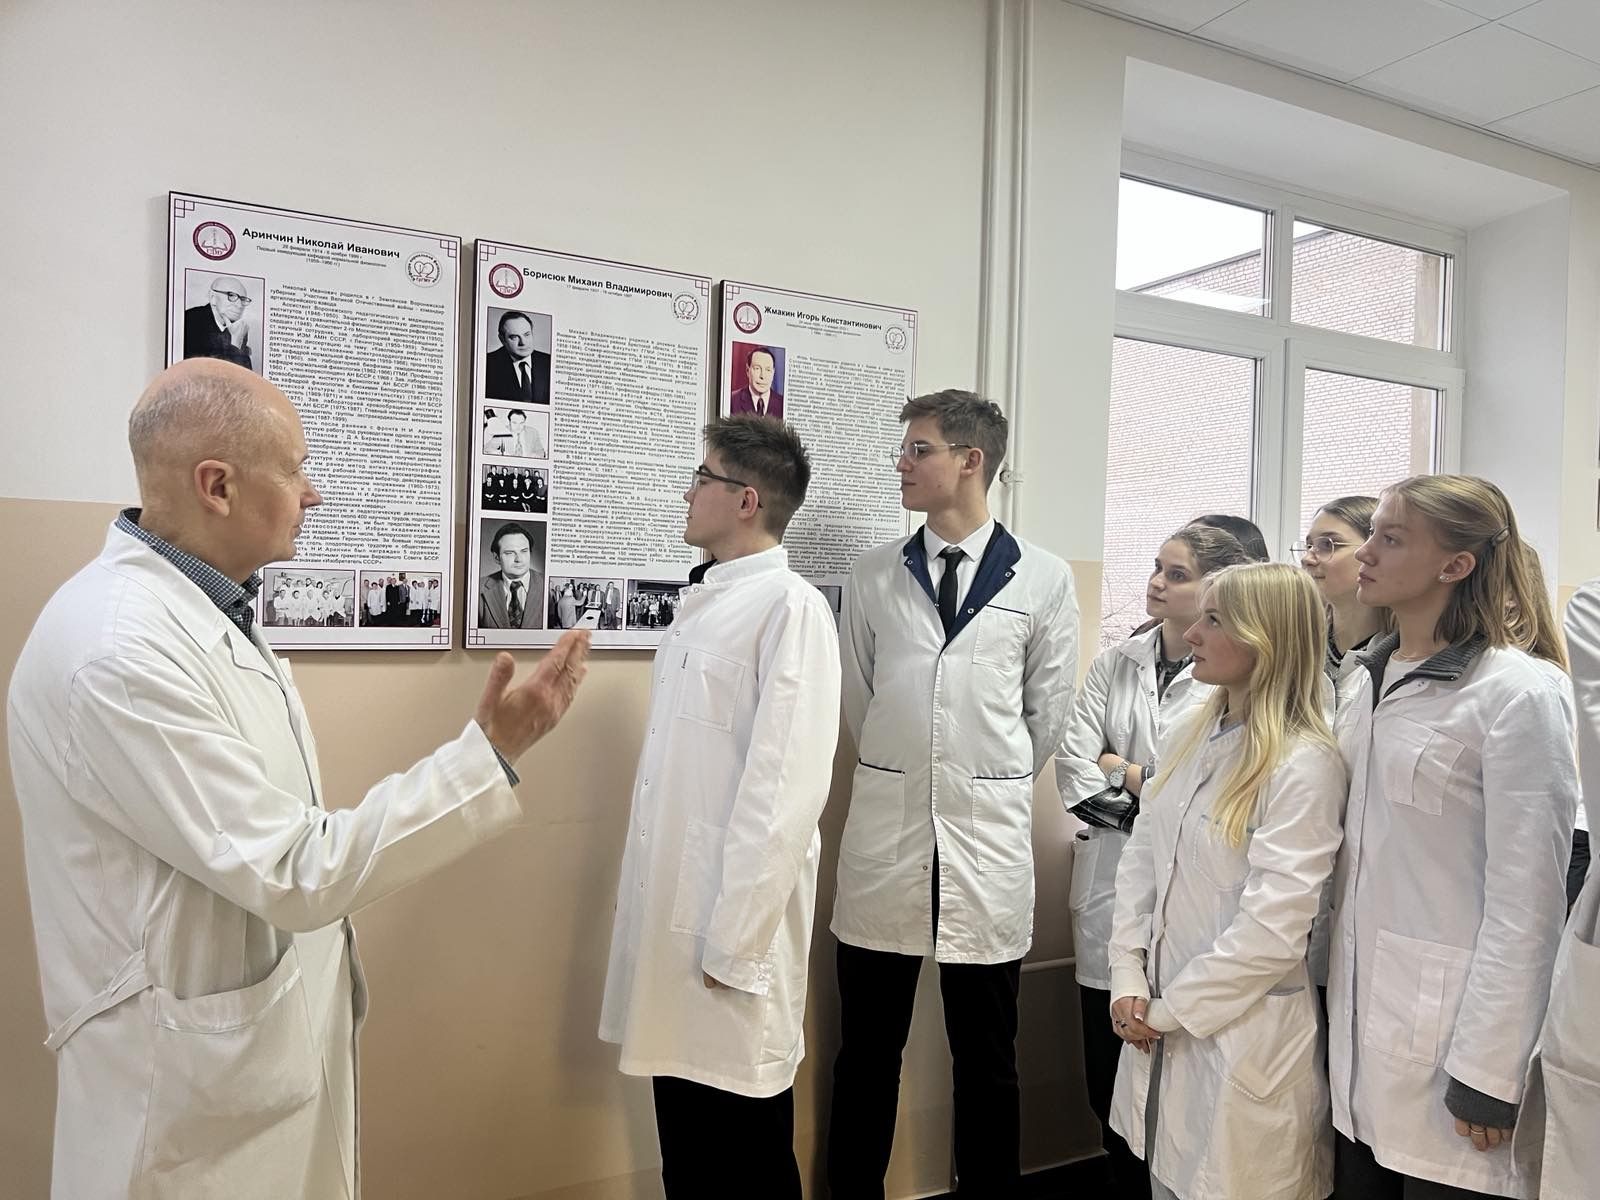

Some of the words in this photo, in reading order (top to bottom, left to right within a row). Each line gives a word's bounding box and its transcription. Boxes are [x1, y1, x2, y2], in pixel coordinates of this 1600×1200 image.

[242, 227, 293, 243] Аринчин
[296, 235, 343, 250] Николай
[346, 242, 399, 258] Иванович
[522, 267, 565, 282] Борисюк
[567, 274, 603, 288] Михаил
[605, 280, 672, 299] Владимирович
[764, 306, 795, 317] Жмакин
[796, 311, 819, 322] Игорь
[821, 315, 881, 330] Константинович
